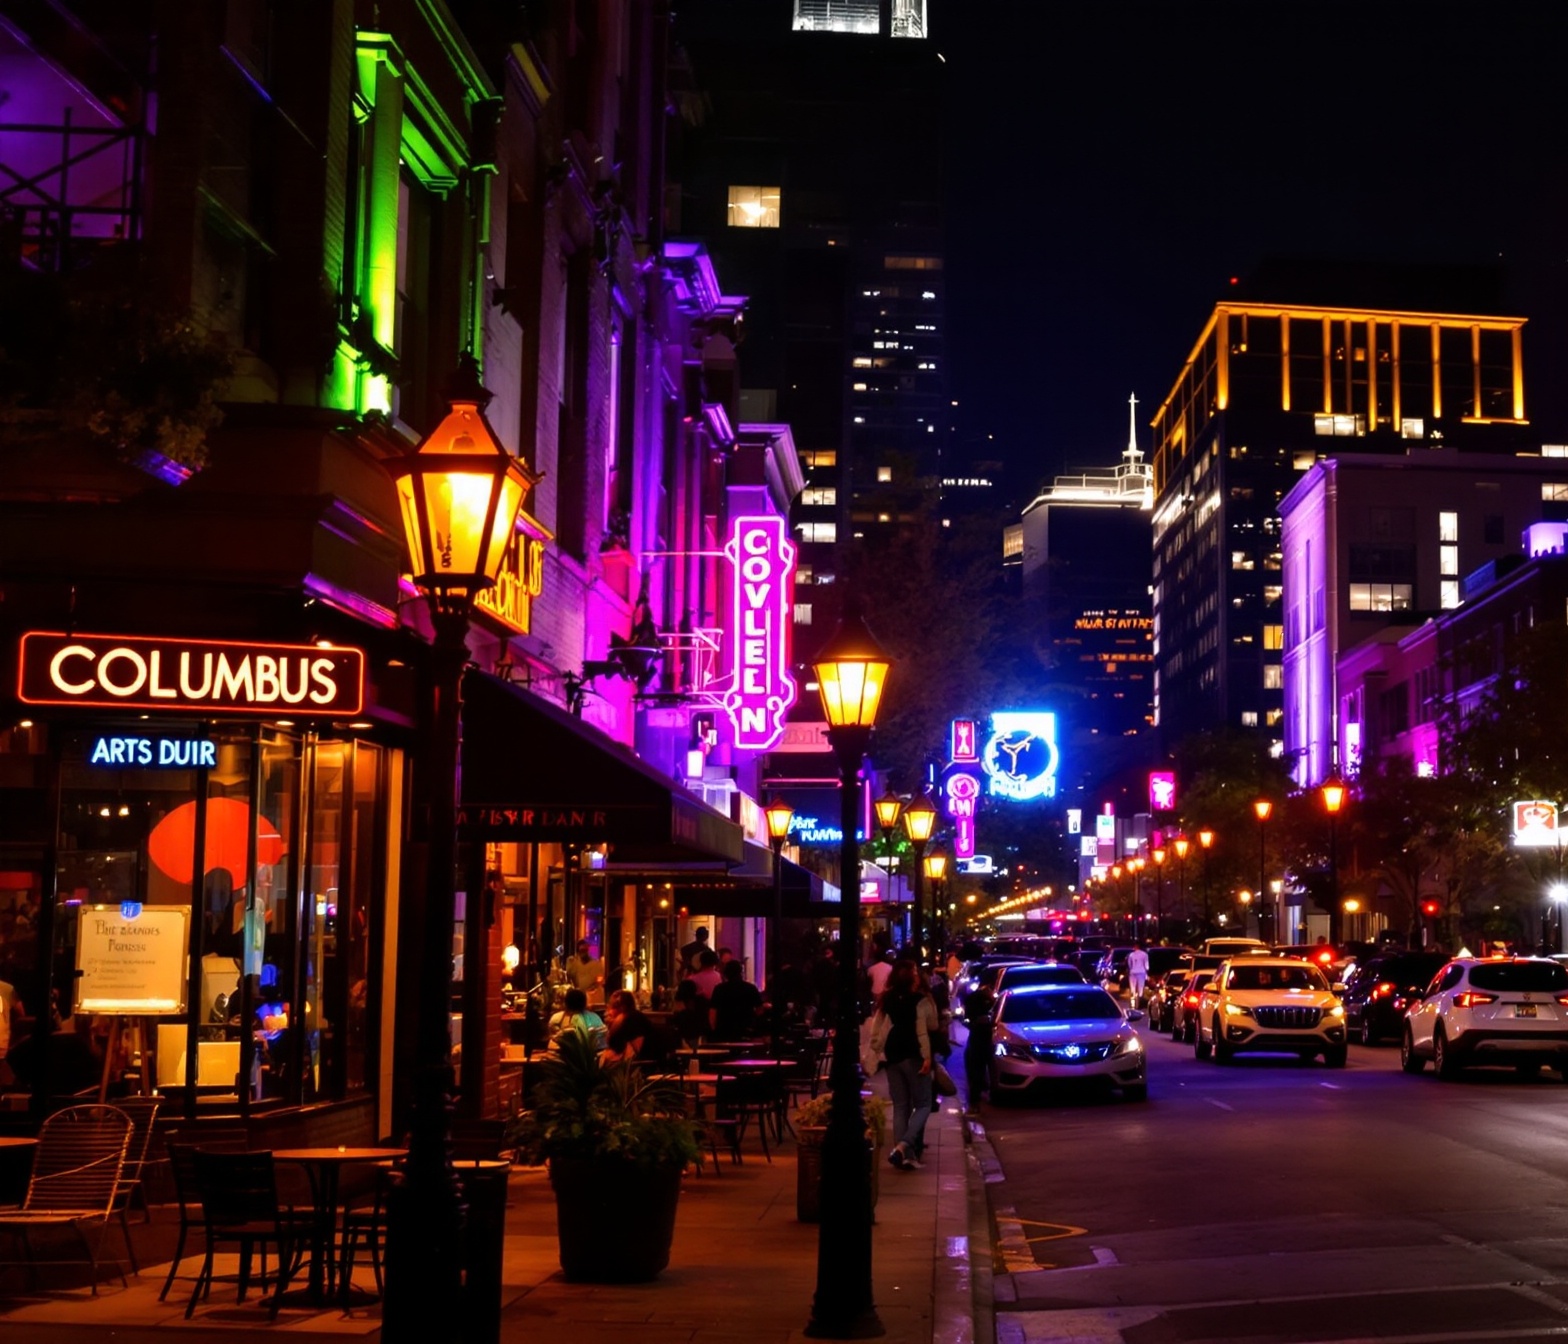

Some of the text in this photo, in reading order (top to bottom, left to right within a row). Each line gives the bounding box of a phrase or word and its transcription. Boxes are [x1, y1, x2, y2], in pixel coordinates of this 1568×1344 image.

[50, 645, 338, 704] COLUMBUS
[91, 737, 216, 765] ARTS DUIR
